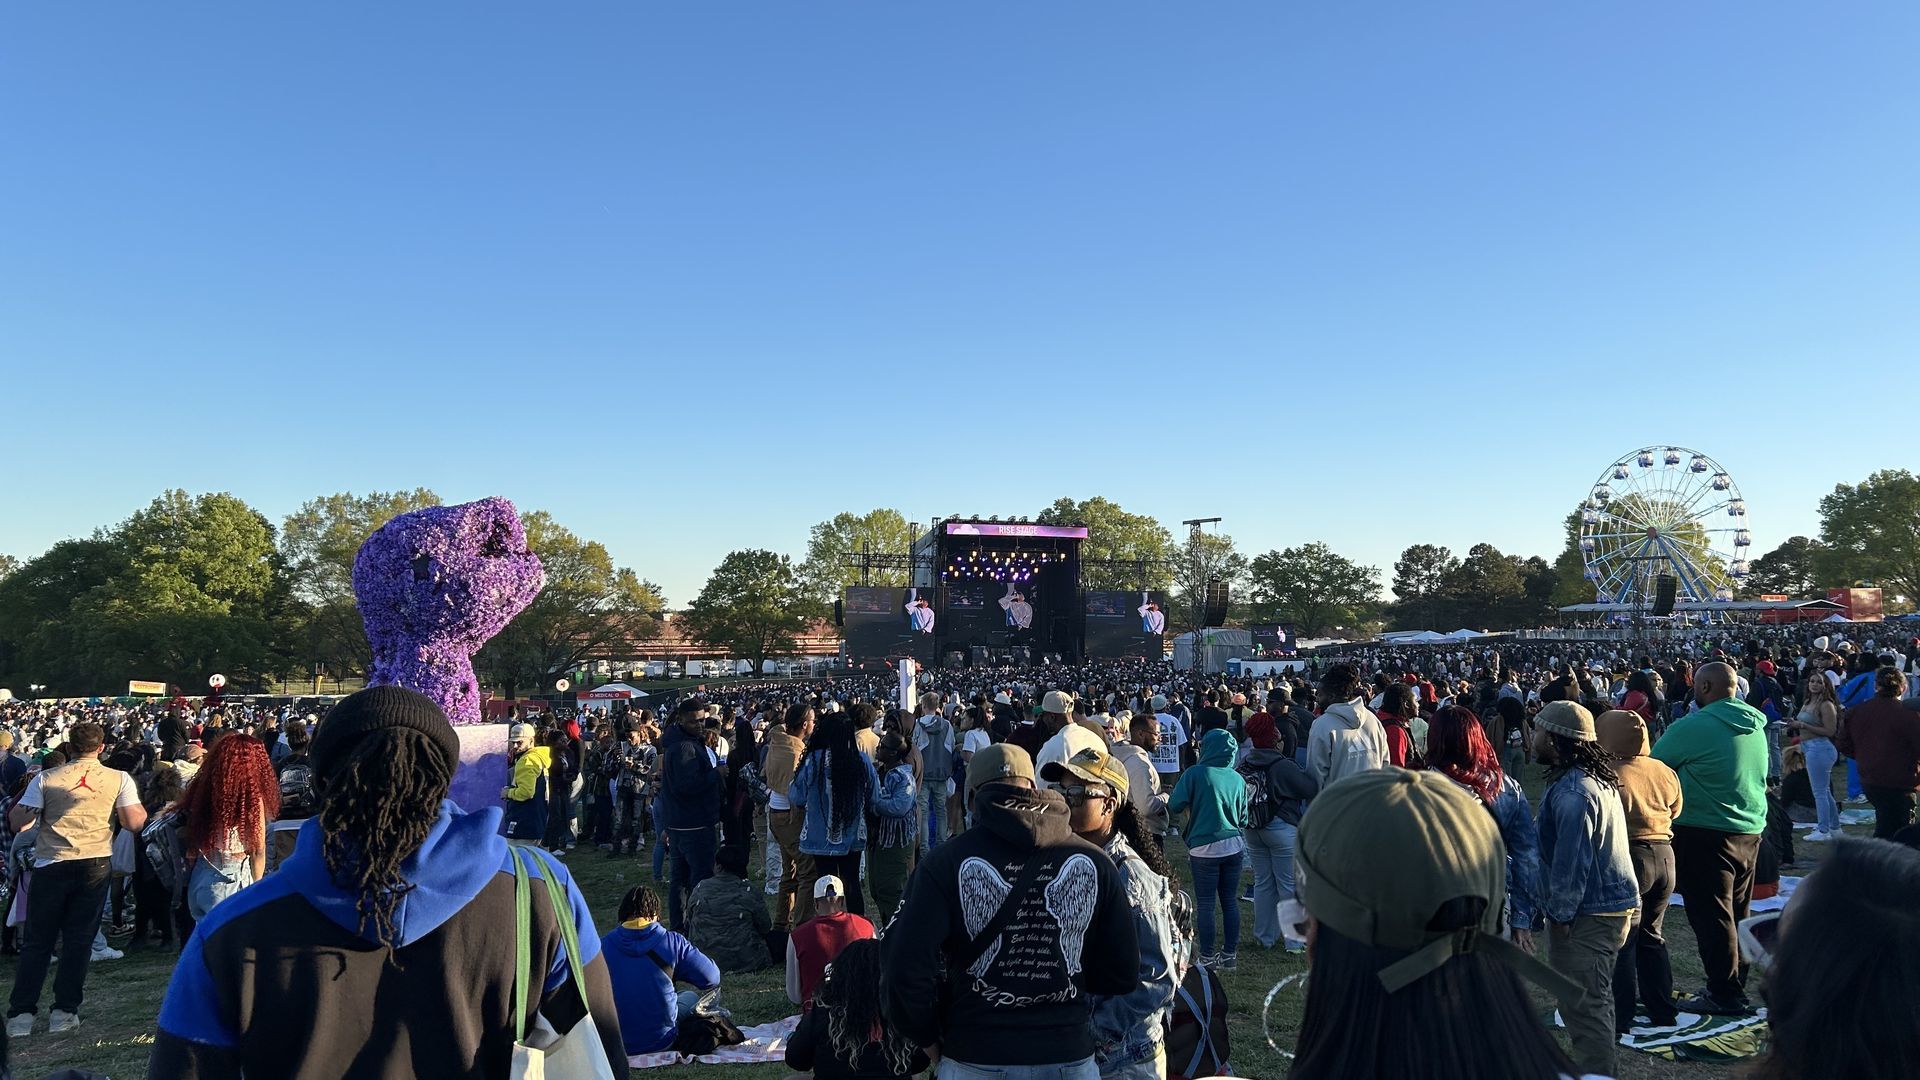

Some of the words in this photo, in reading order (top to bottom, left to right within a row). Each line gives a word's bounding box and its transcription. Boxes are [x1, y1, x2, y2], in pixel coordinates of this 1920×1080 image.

[998, 526, 1015, 534] RISE
[1015, 526, 1038, 535] STAGE
[1004, 862, 1025, 873] Angel
[1026, 933, 1039, 941] this
[1040, 934, 1053, 944] day
